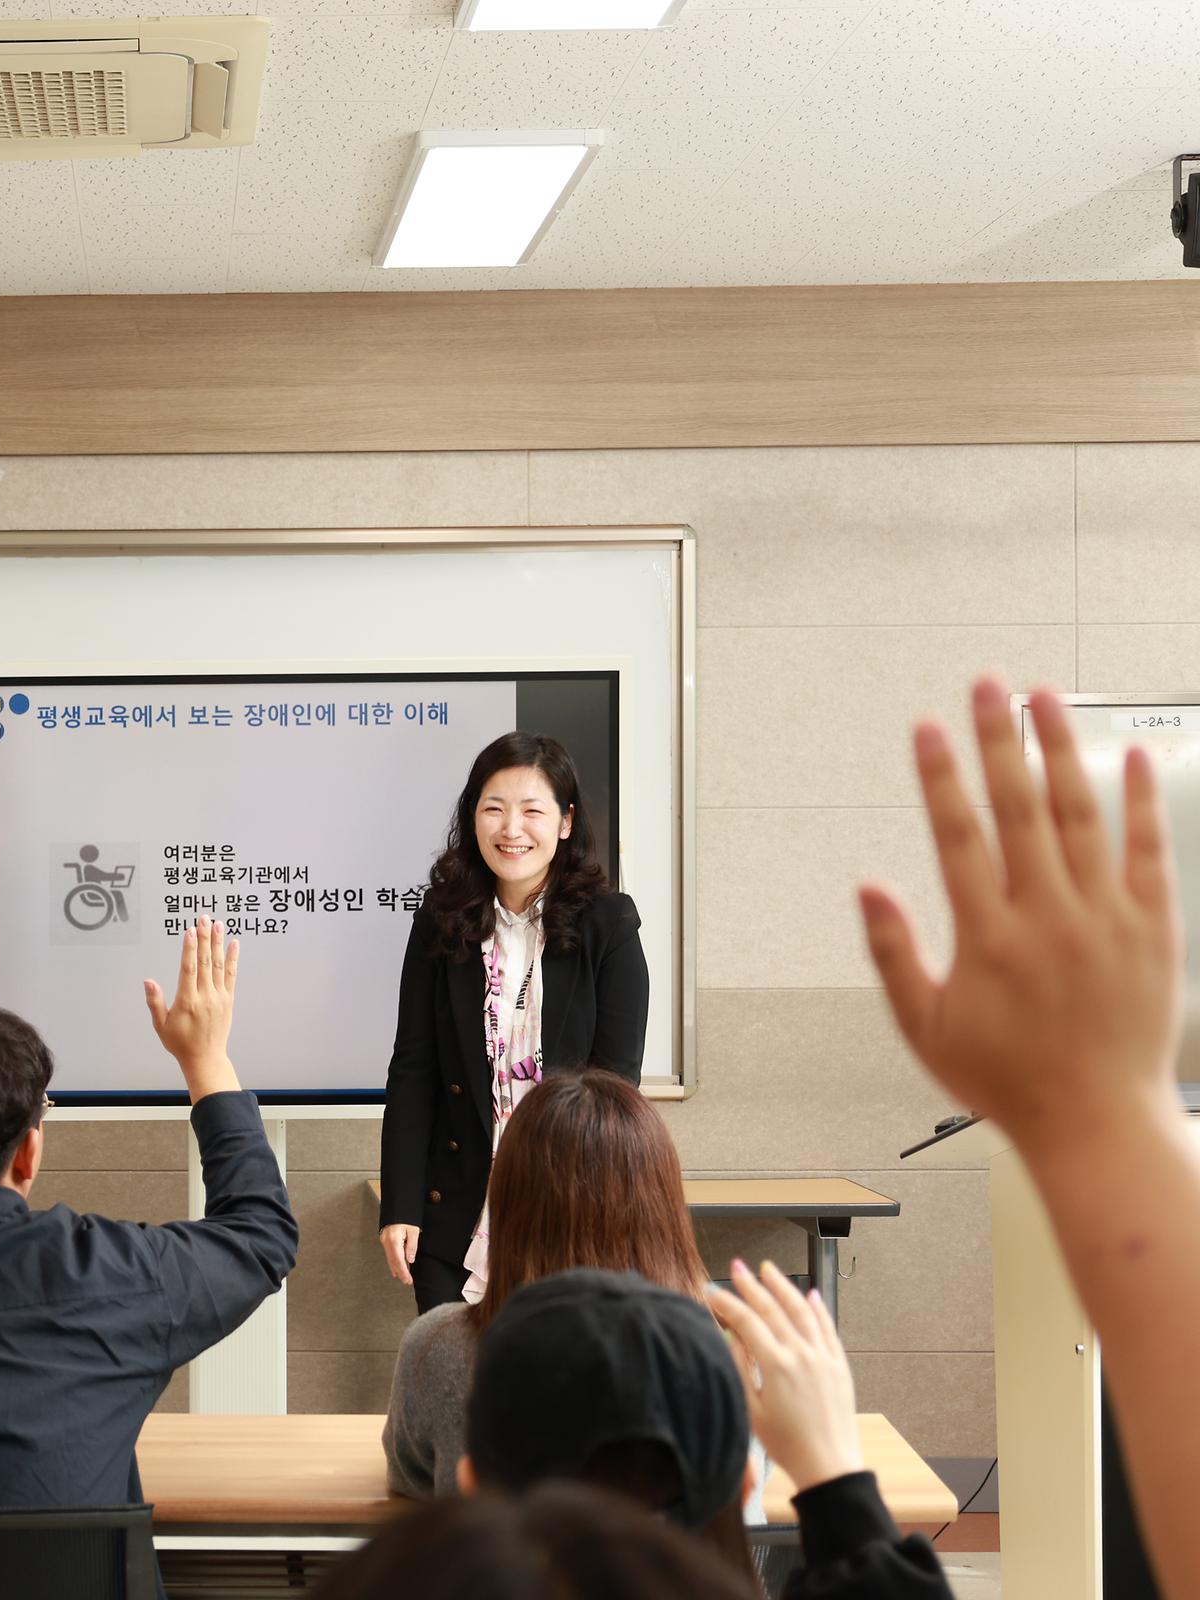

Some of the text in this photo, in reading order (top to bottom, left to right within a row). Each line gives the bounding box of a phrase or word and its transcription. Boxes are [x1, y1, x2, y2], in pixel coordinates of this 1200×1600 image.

[37, 701, 448, 729] 평생교육에서 보는 장애인에 대한 이해
[1132, 716, 1182, 728] L-2A-3
[163, 844, 236, 863] 여러분은
[163, 866, 309, 885] 평생교육기관에서
[163, 894, 218, 913] 얼마나
[225, 894, 261, 913] 많은
[268, 887, 364, 913] 장애성인
[225, 917, 289, 936] 있나요?
